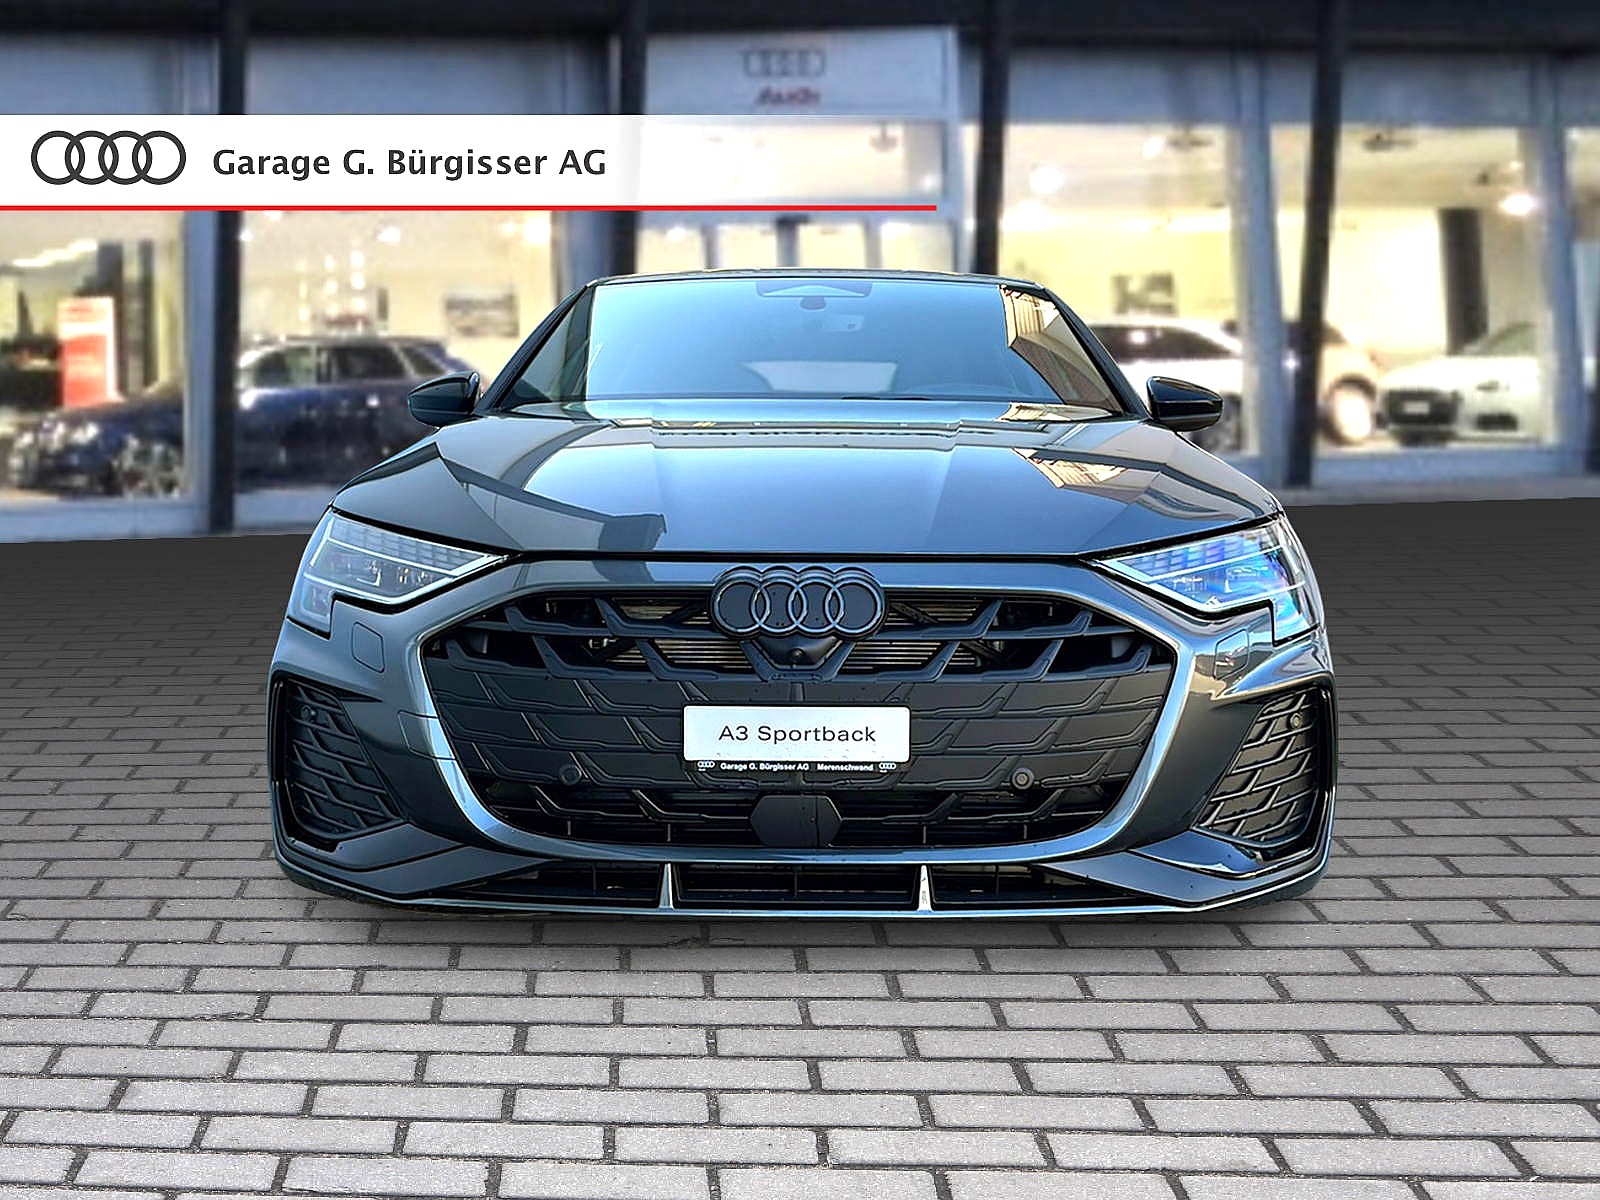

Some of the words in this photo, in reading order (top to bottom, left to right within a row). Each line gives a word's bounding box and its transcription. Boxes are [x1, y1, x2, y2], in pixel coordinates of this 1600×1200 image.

[718, 725, 749, 741] A3
[757, 725, 876, 745] Sportback
[720, 762, 747, 772] Garage
[797, 762, 810, 771] AG
[816, 762, 874, 772] Merenschwand
